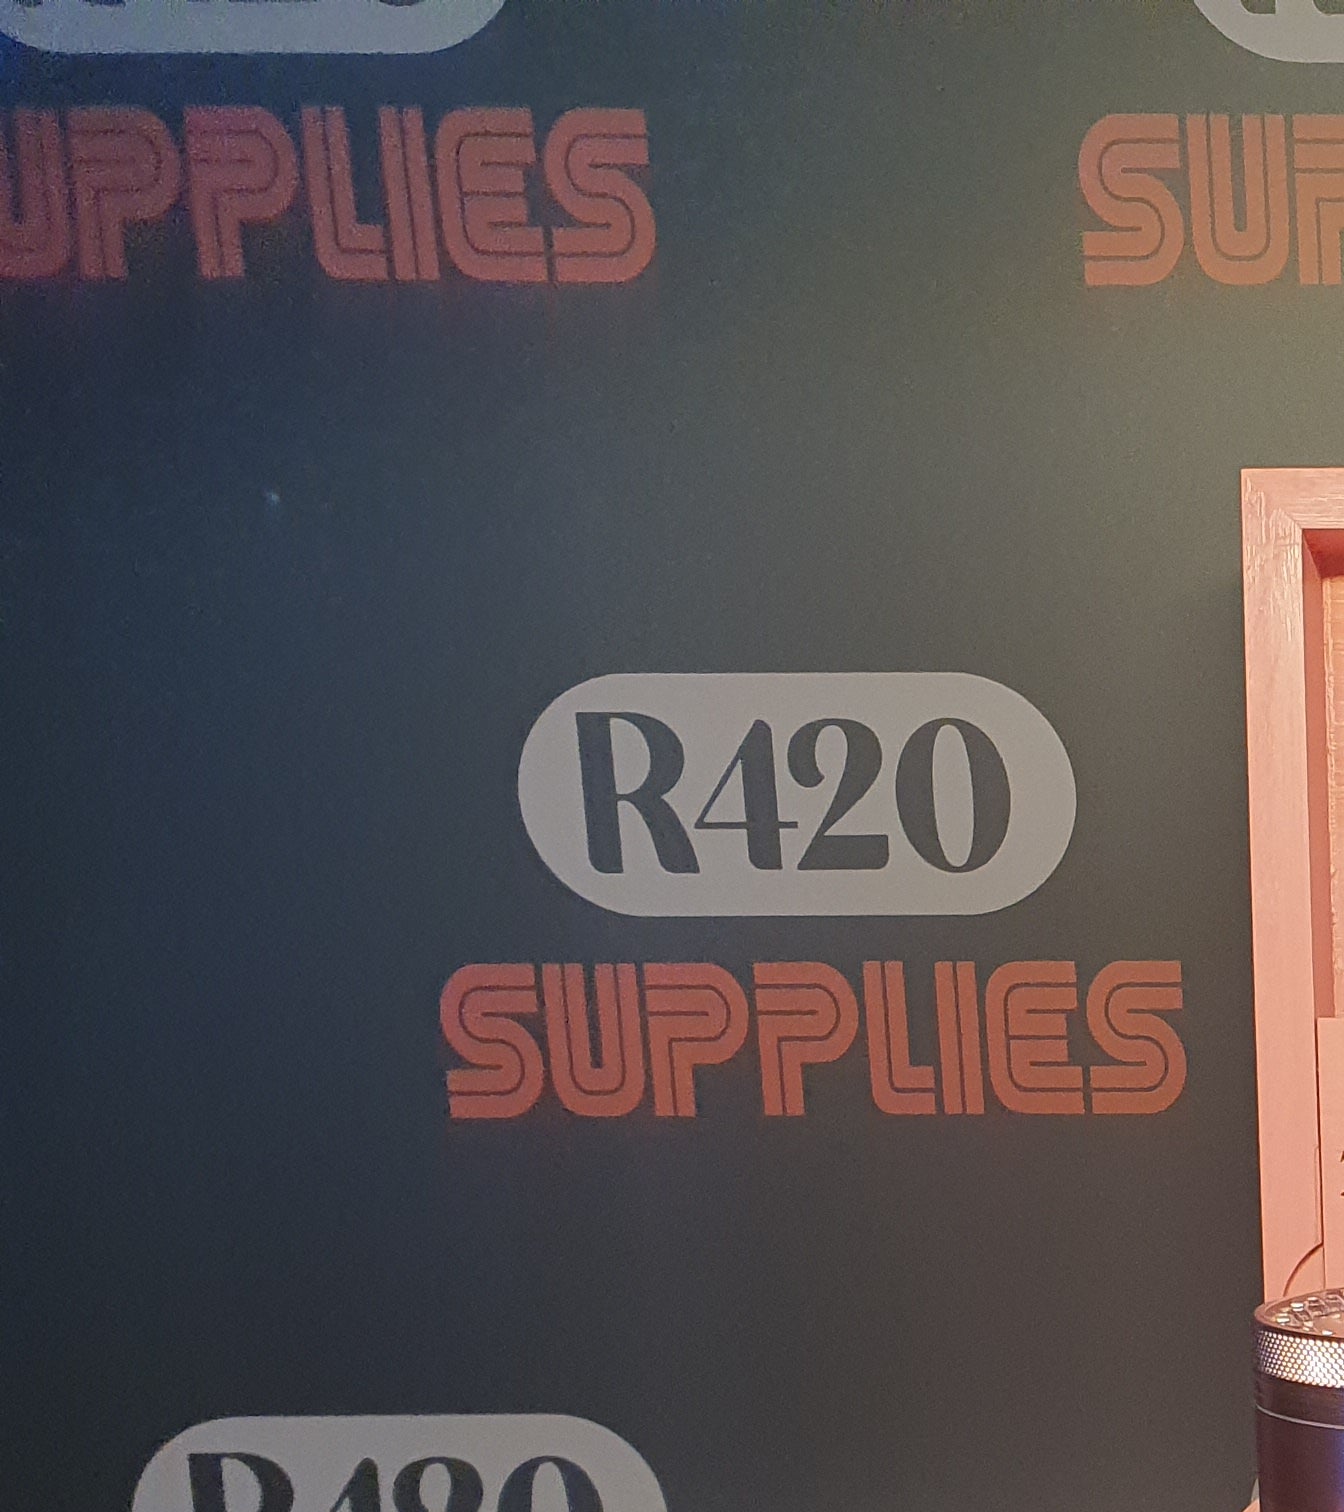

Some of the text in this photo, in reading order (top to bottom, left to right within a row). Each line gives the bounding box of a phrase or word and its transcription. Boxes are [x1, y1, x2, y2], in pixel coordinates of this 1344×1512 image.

[0, 107, 656, 283] UPPLIES
[575, 711, 1011, 874] R420
[440, 960, 1187, 1118] SUPPLIES
